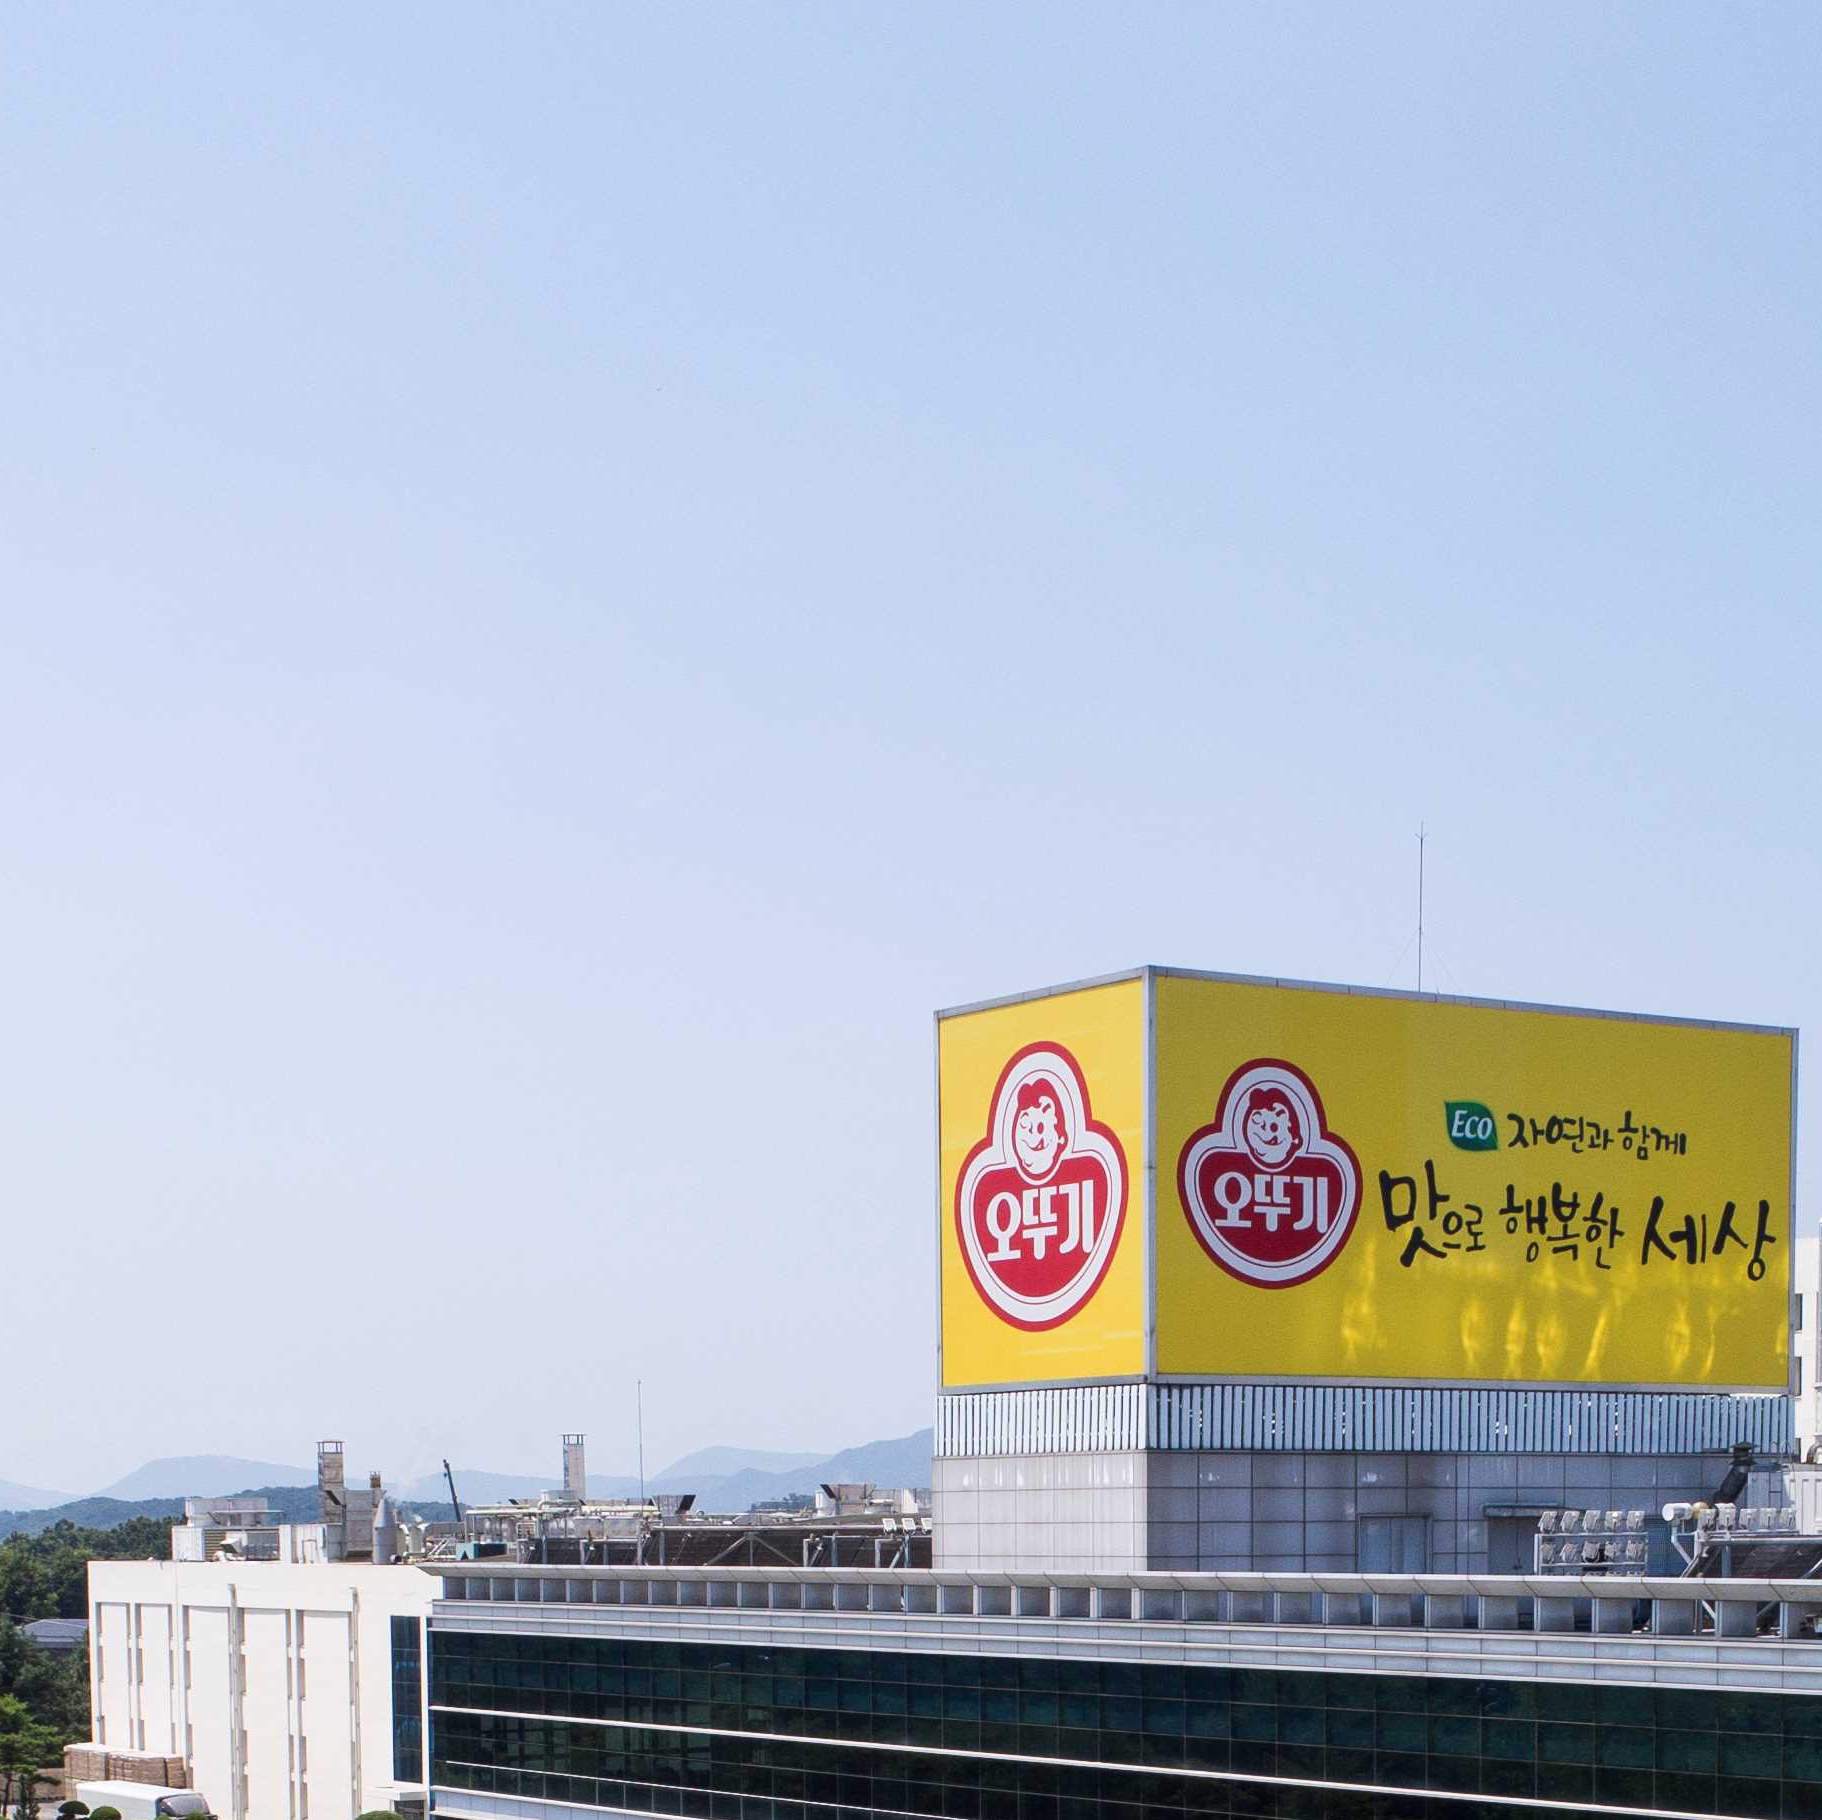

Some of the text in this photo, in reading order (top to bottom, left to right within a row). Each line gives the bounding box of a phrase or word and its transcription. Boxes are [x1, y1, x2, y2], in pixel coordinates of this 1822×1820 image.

[1451, 1109, 1493, 1141] Eco
[1506, 1110, 1687, 1161] 자연과 함께
[985, 1179, 1094, 1262] 오뚜기
[1213, 1171, 1329, 1234] 오뚜기
[1378, 1159, 1777, 1282] 맛으로 행복한 세상
